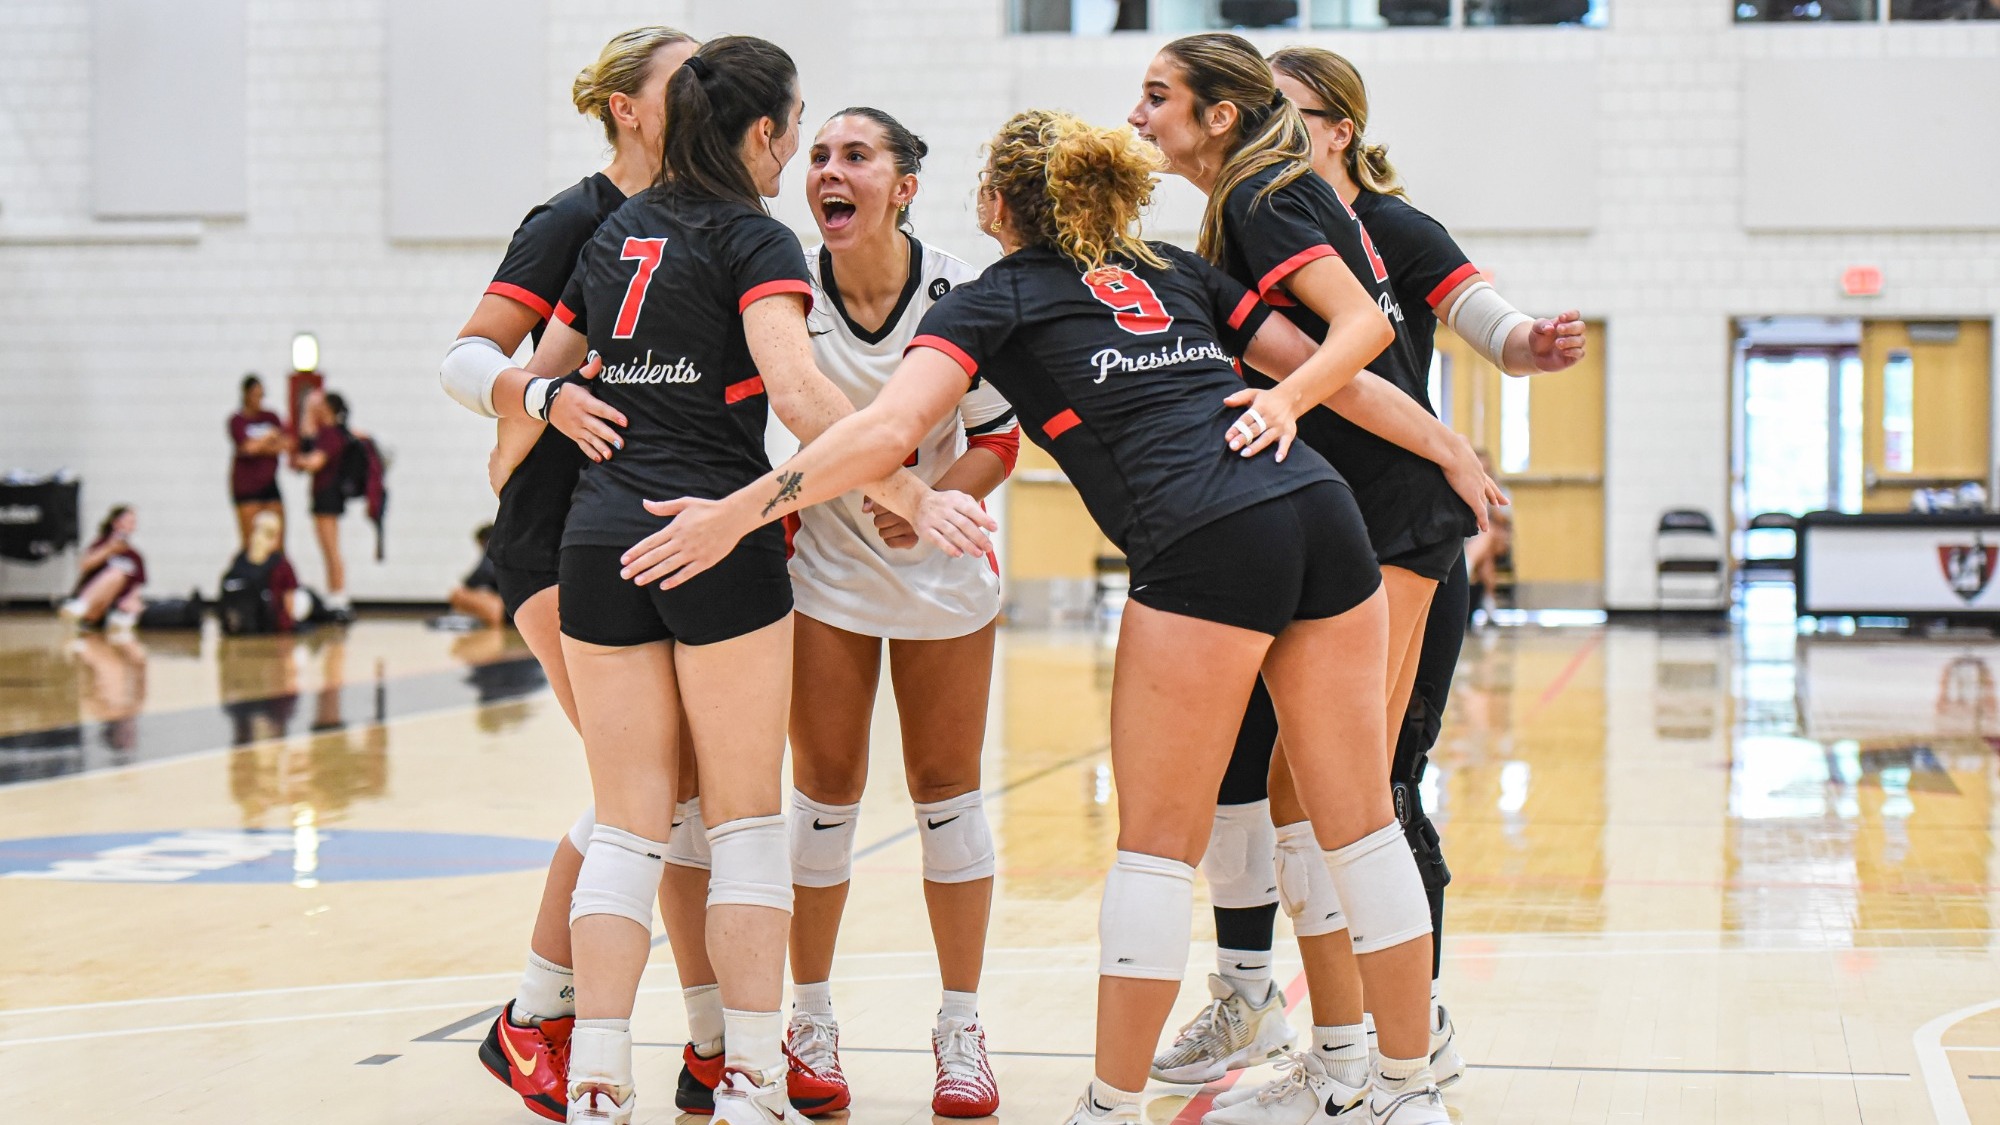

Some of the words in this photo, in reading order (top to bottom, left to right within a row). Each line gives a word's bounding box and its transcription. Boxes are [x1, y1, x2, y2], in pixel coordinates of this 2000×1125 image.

[612, 236, 668, 340] 7
[933, 282, 946, 296] VS
[1081, 265, 1174, 335] 9
